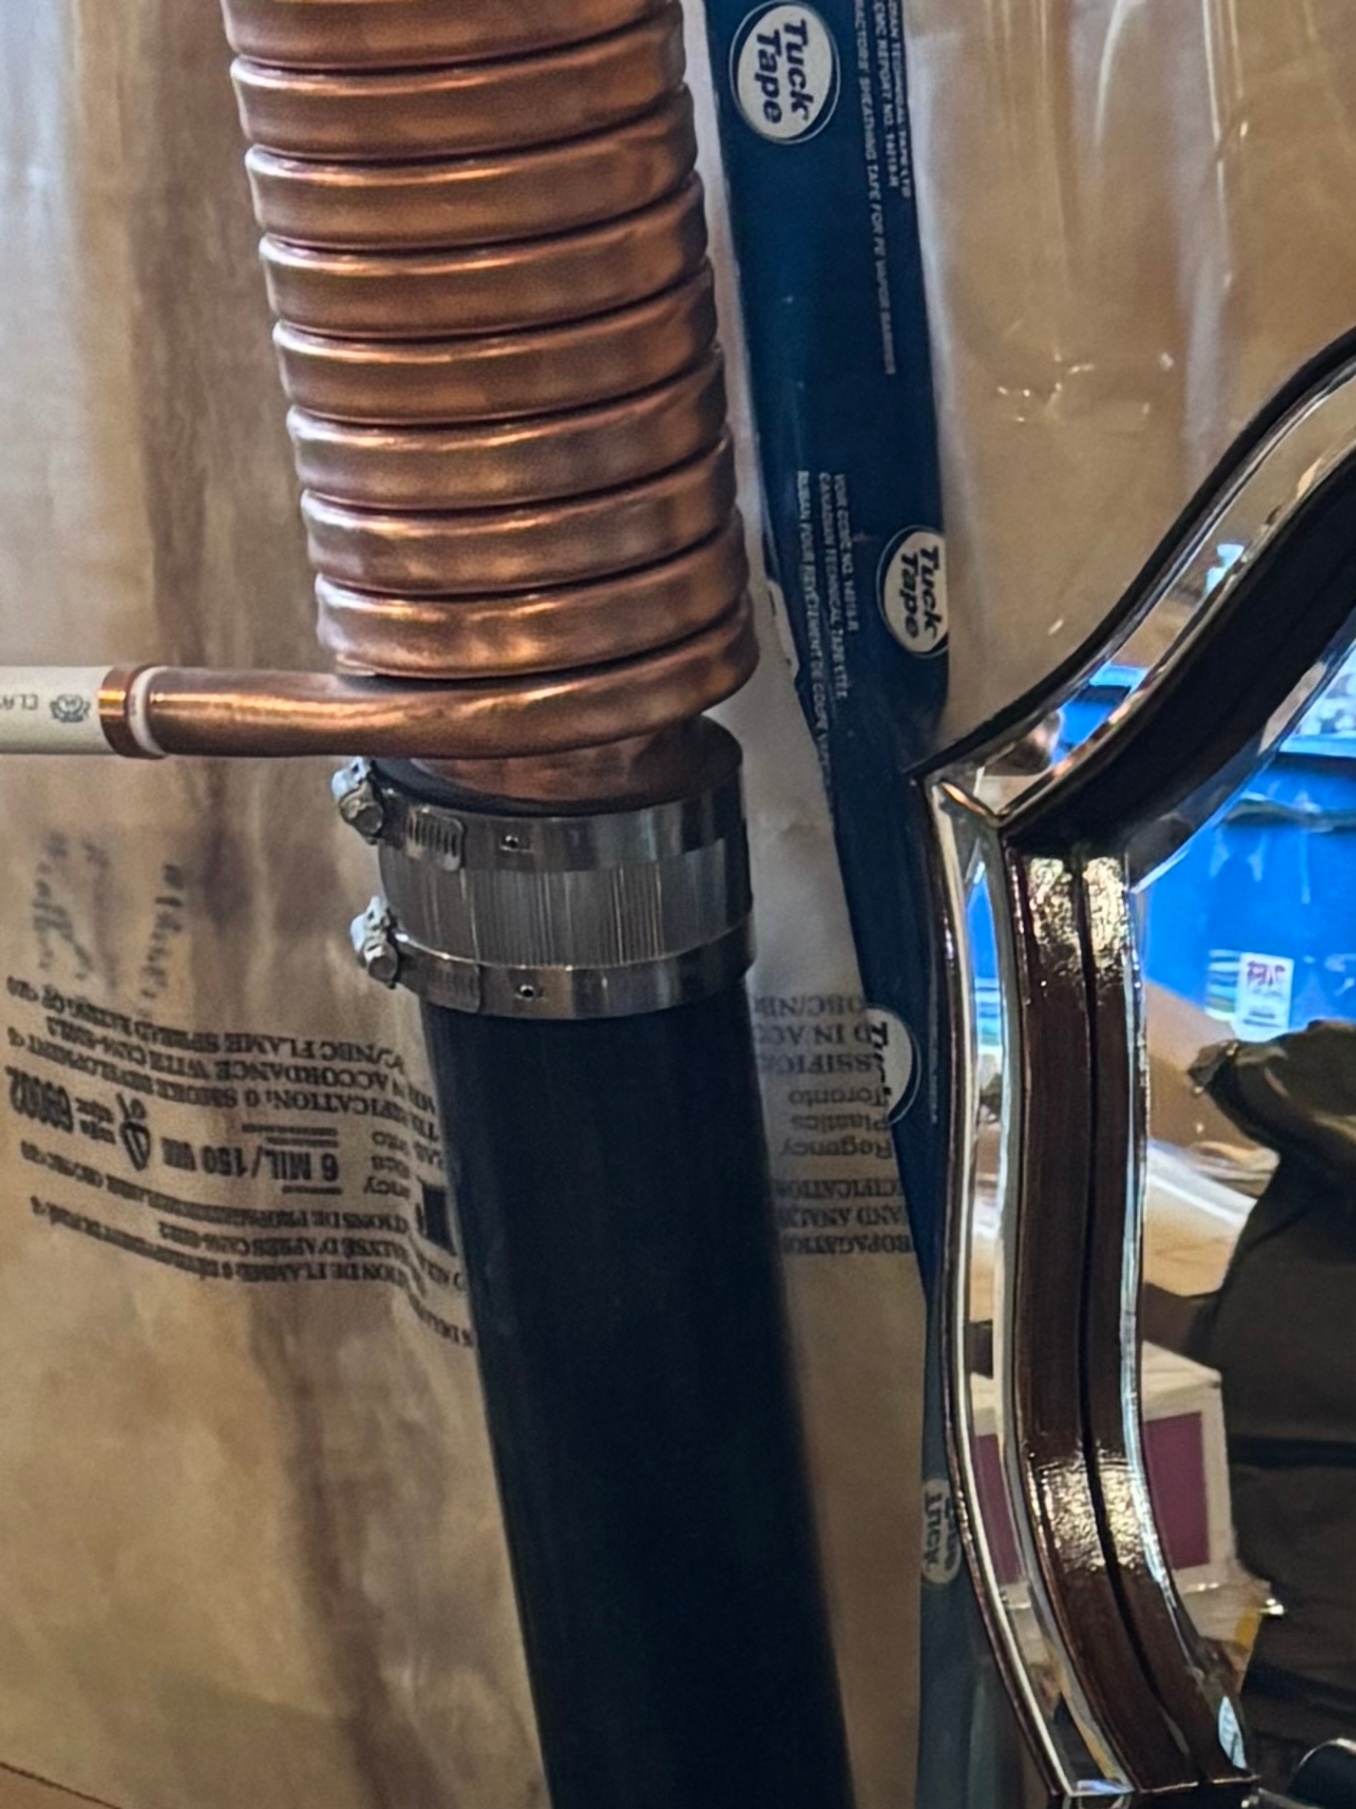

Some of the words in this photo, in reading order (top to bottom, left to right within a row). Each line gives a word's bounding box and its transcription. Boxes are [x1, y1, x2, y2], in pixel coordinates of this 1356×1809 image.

[754, 29, 784, 125] Tape
[784, 19, 814, 121] Tuck
[876, 38, 891, 100] REPORT
[900, 553, 920, 638] Tape
[918, 546, 944, 639] Tuck
[222, 1031, 316, 1060] FLAME
[812, 1022, 845, 1045] IN
[215, 1057, 389, 1092] ACCORDANCE
[789, 1086, 885, 1109] Toronto
[791, 1112, 889, 1133] Plastics
[779, 1133, 893, 1159] Regency
[318, 1151, 341, 1182] 6
